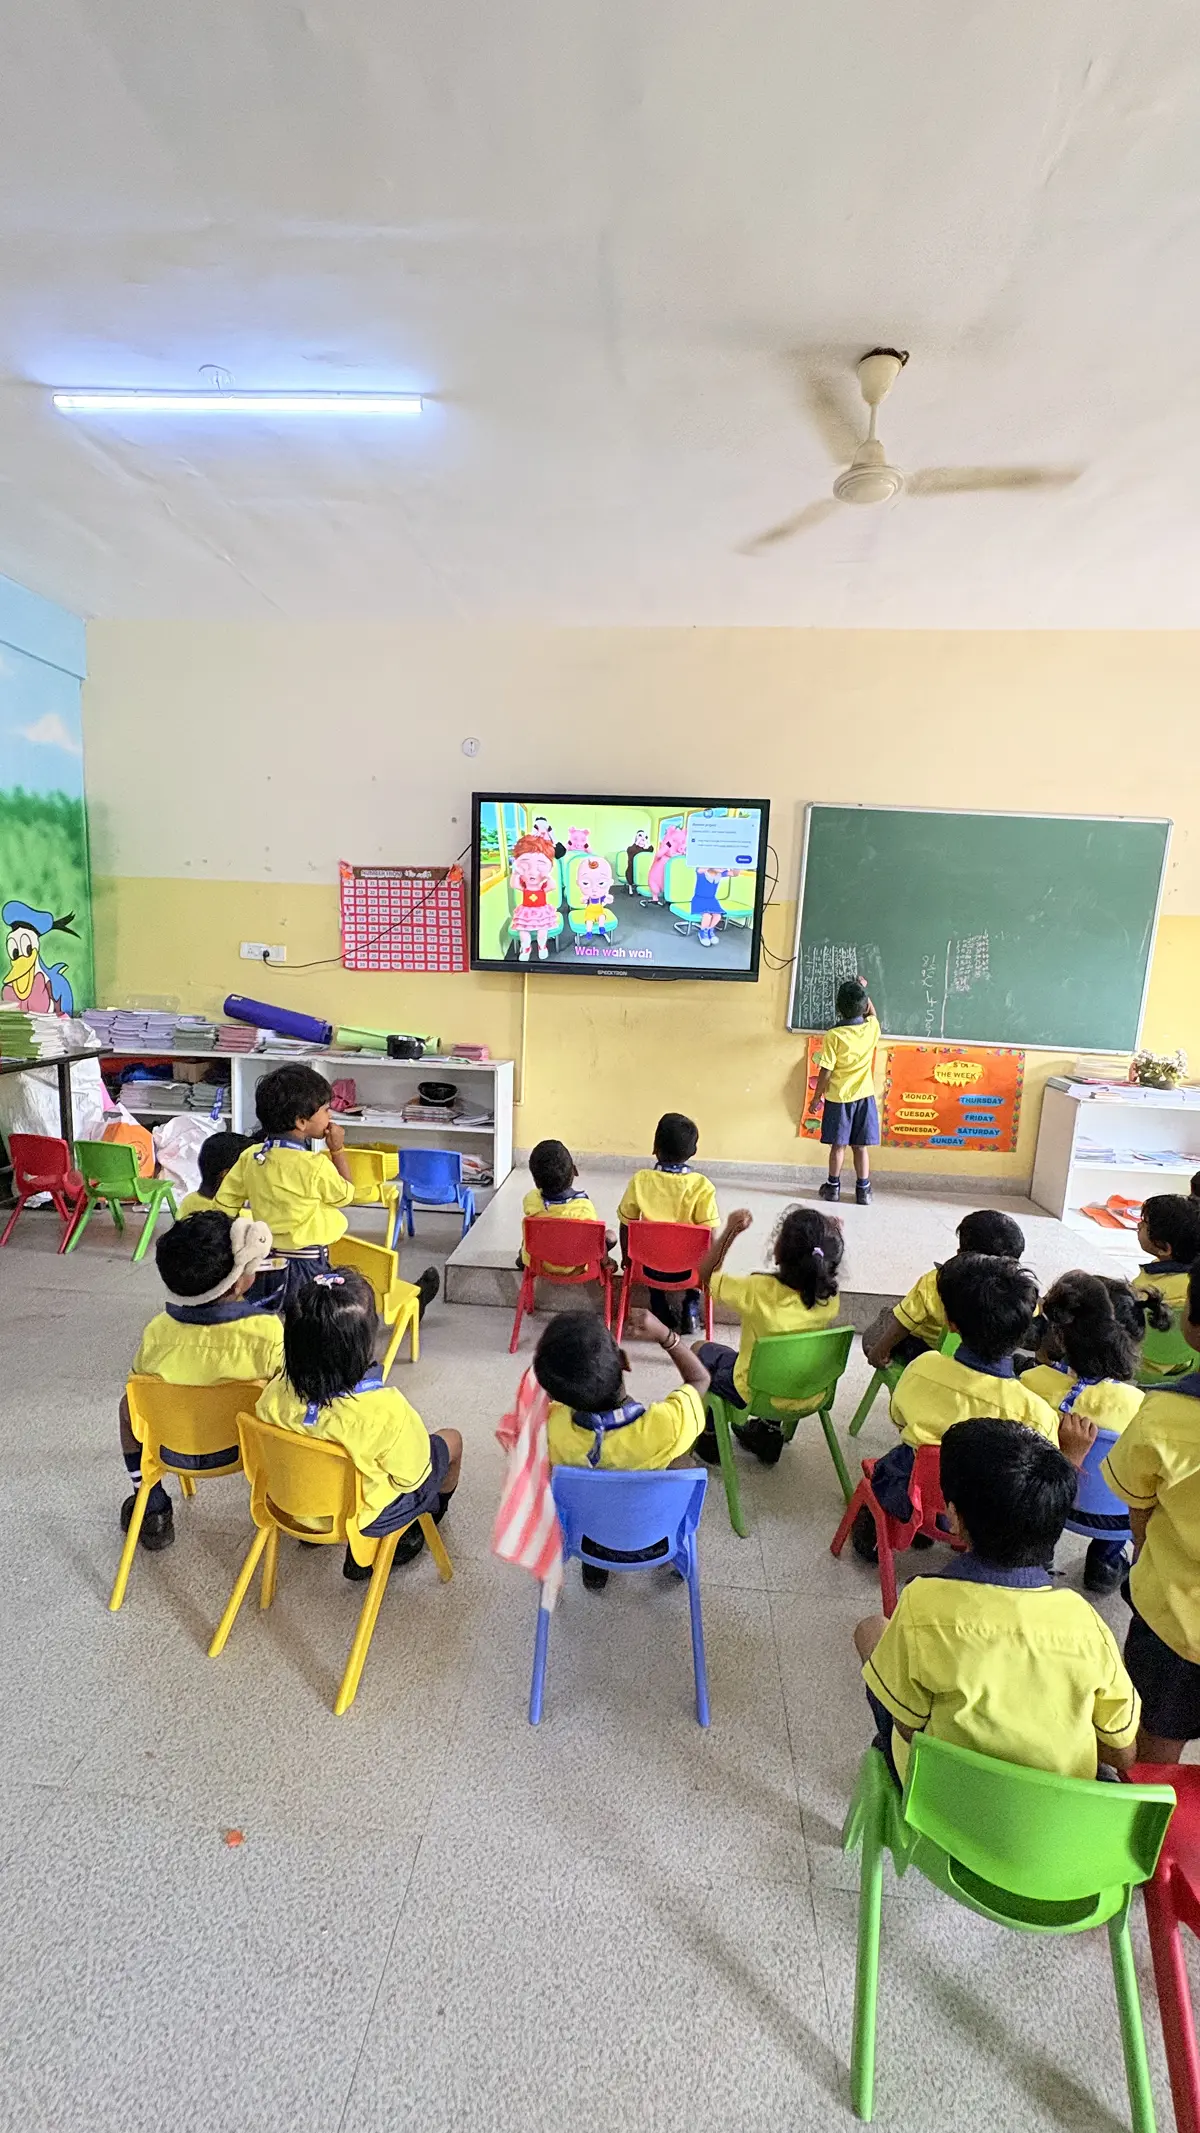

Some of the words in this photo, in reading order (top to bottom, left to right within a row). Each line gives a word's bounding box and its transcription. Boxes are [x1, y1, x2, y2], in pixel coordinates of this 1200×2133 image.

[575, 946, 599, 956] Wah
[602, 948, 626, 957] wah
[629, 949, 652, 958] wah
